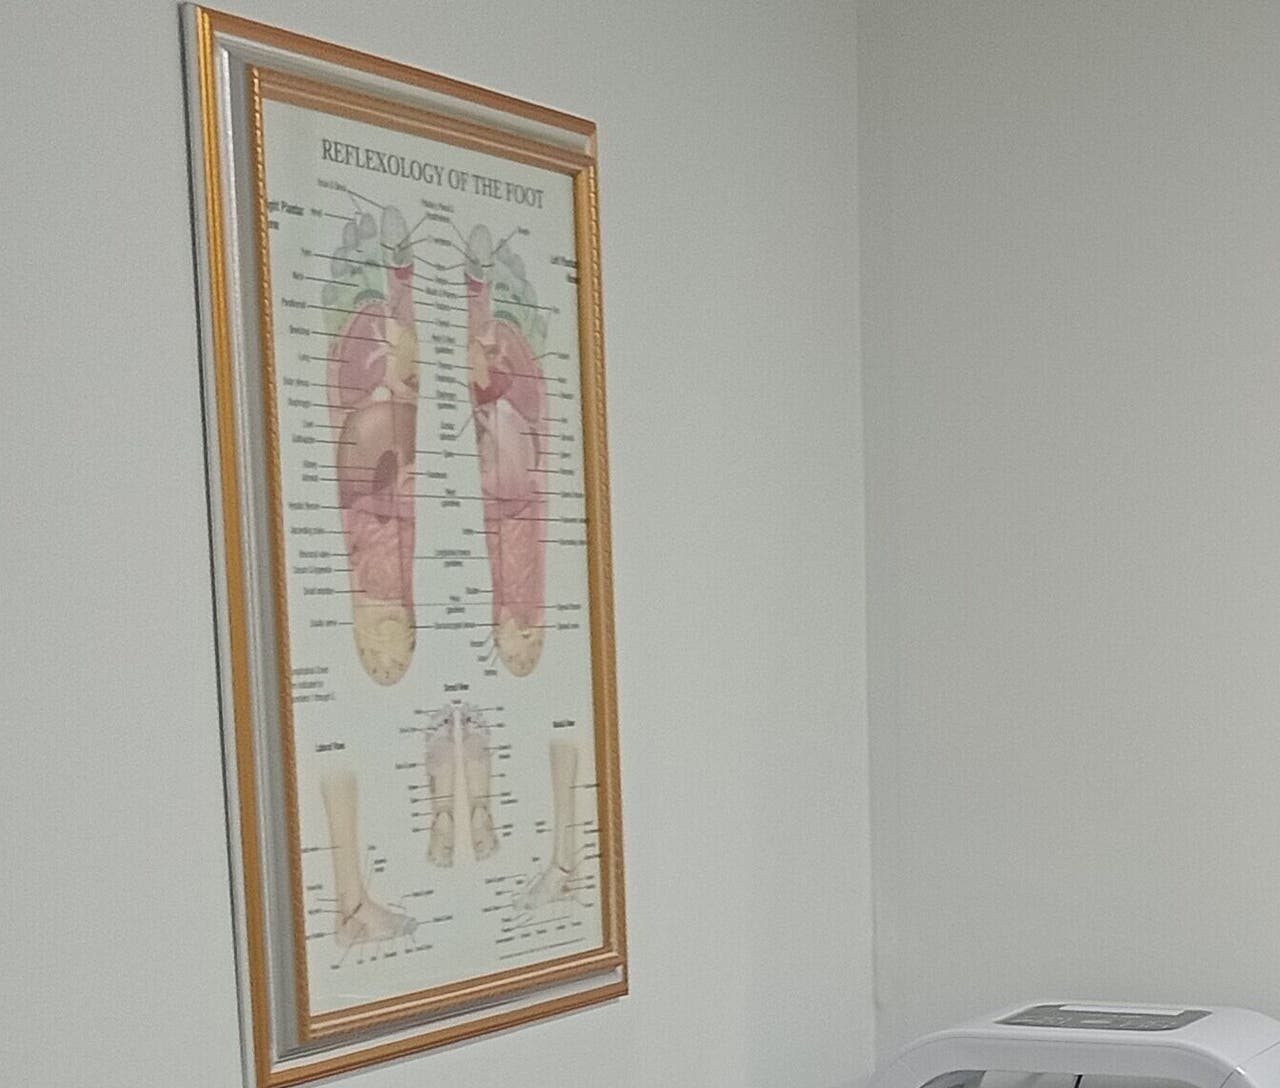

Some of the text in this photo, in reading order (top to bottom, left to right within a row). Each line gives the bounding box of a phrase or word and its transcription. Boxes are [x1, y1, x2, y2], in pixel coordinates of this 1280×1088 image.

[322, 138, 445, 187] REFLEXOLOGY
[448, 169, 470, 191] OF
[472, 174, 503, 199] THE
[505, 182, 544, 209] FOOT
